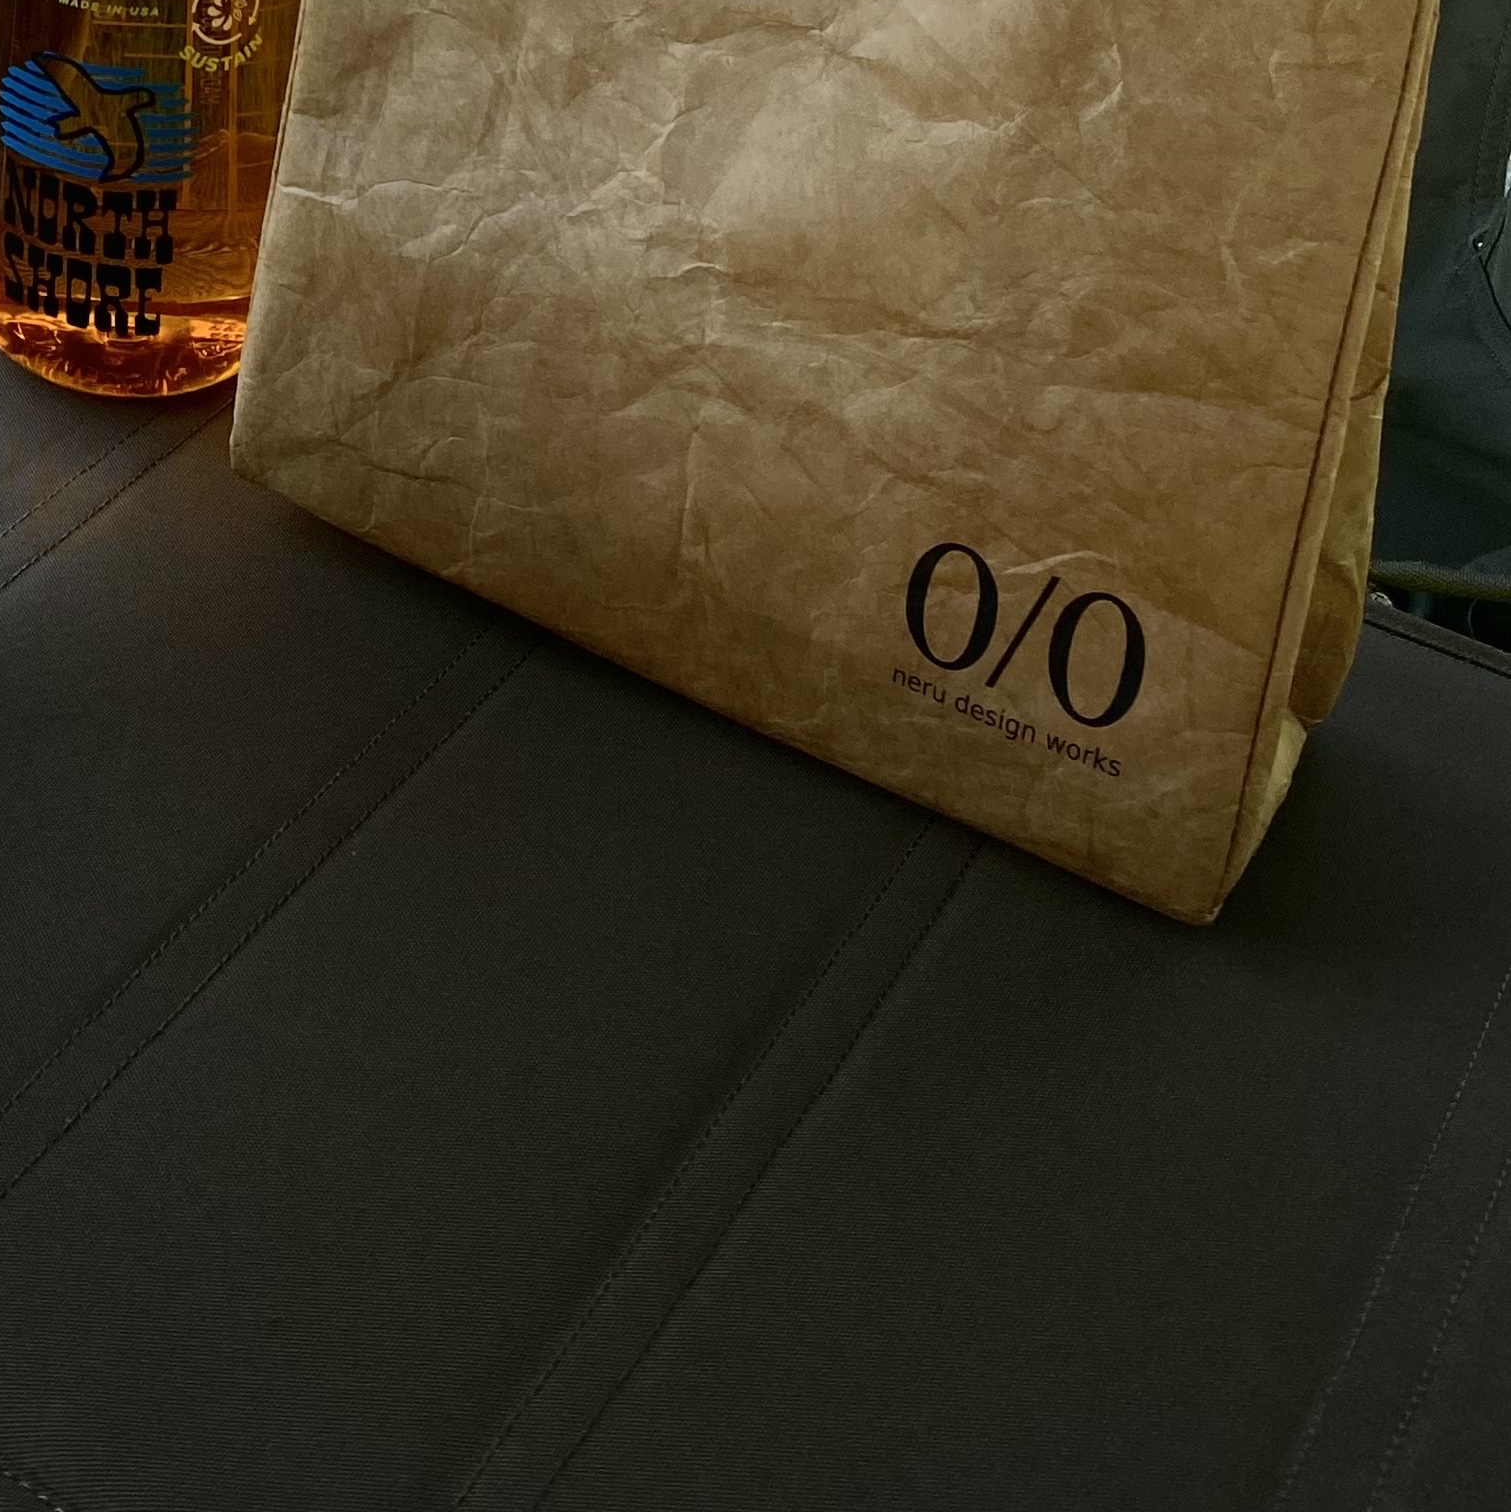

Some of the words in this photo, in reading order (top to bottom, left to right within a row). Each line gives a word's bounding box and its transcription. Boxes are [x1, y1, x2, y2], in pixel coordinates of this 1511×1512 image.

[105, 4, 124, 17] IN
[129, 5, 161, 19] USA
[178, 34, 264, 72] SUSTAIN
[4, 162, 177, 265] NORTH
[3, 232, 163, 337] SHORE
[891, 667, 945, 705] neru
[954, 695, 1037, 744] design
[1046, 732, 1122, 777] works
